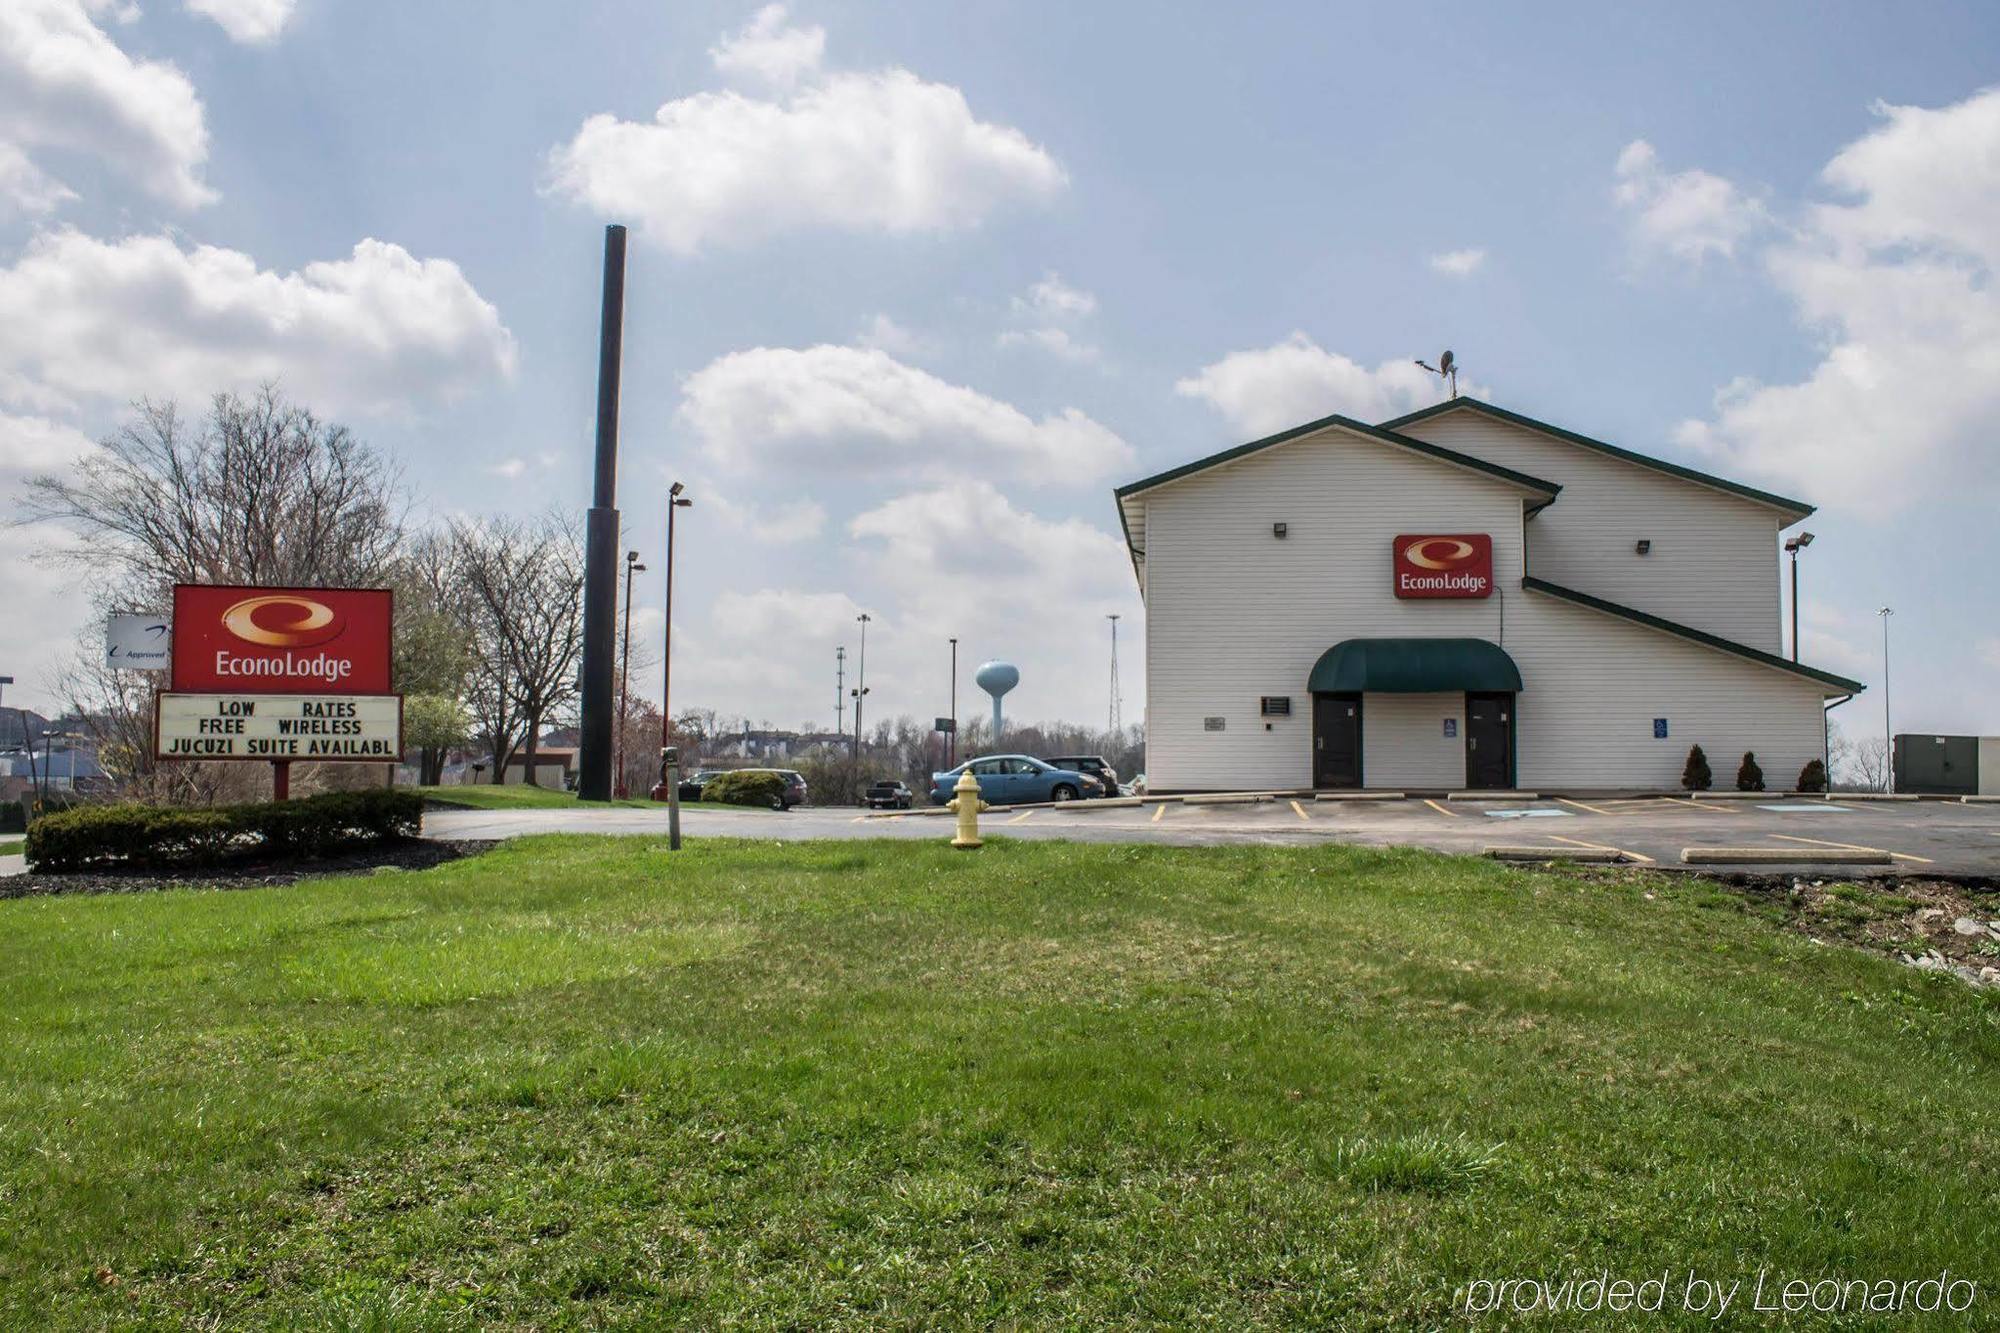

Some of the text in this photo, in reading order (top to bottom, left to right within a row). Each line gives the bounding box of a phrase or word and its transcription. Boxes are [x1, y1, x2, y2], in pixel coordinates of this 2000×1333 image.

[1401, 573, 1487, 593] EconoLodge
[126, 651, 165, 659] Approved
[215, 650, 352, 682] EconoLodge
[219, 701, 356, 717] LOW RATES
[200, 719, 362, 735] FREE WIRELESS
[169, 739, 393, 755] JUCUZI SUITE AVAILABL
